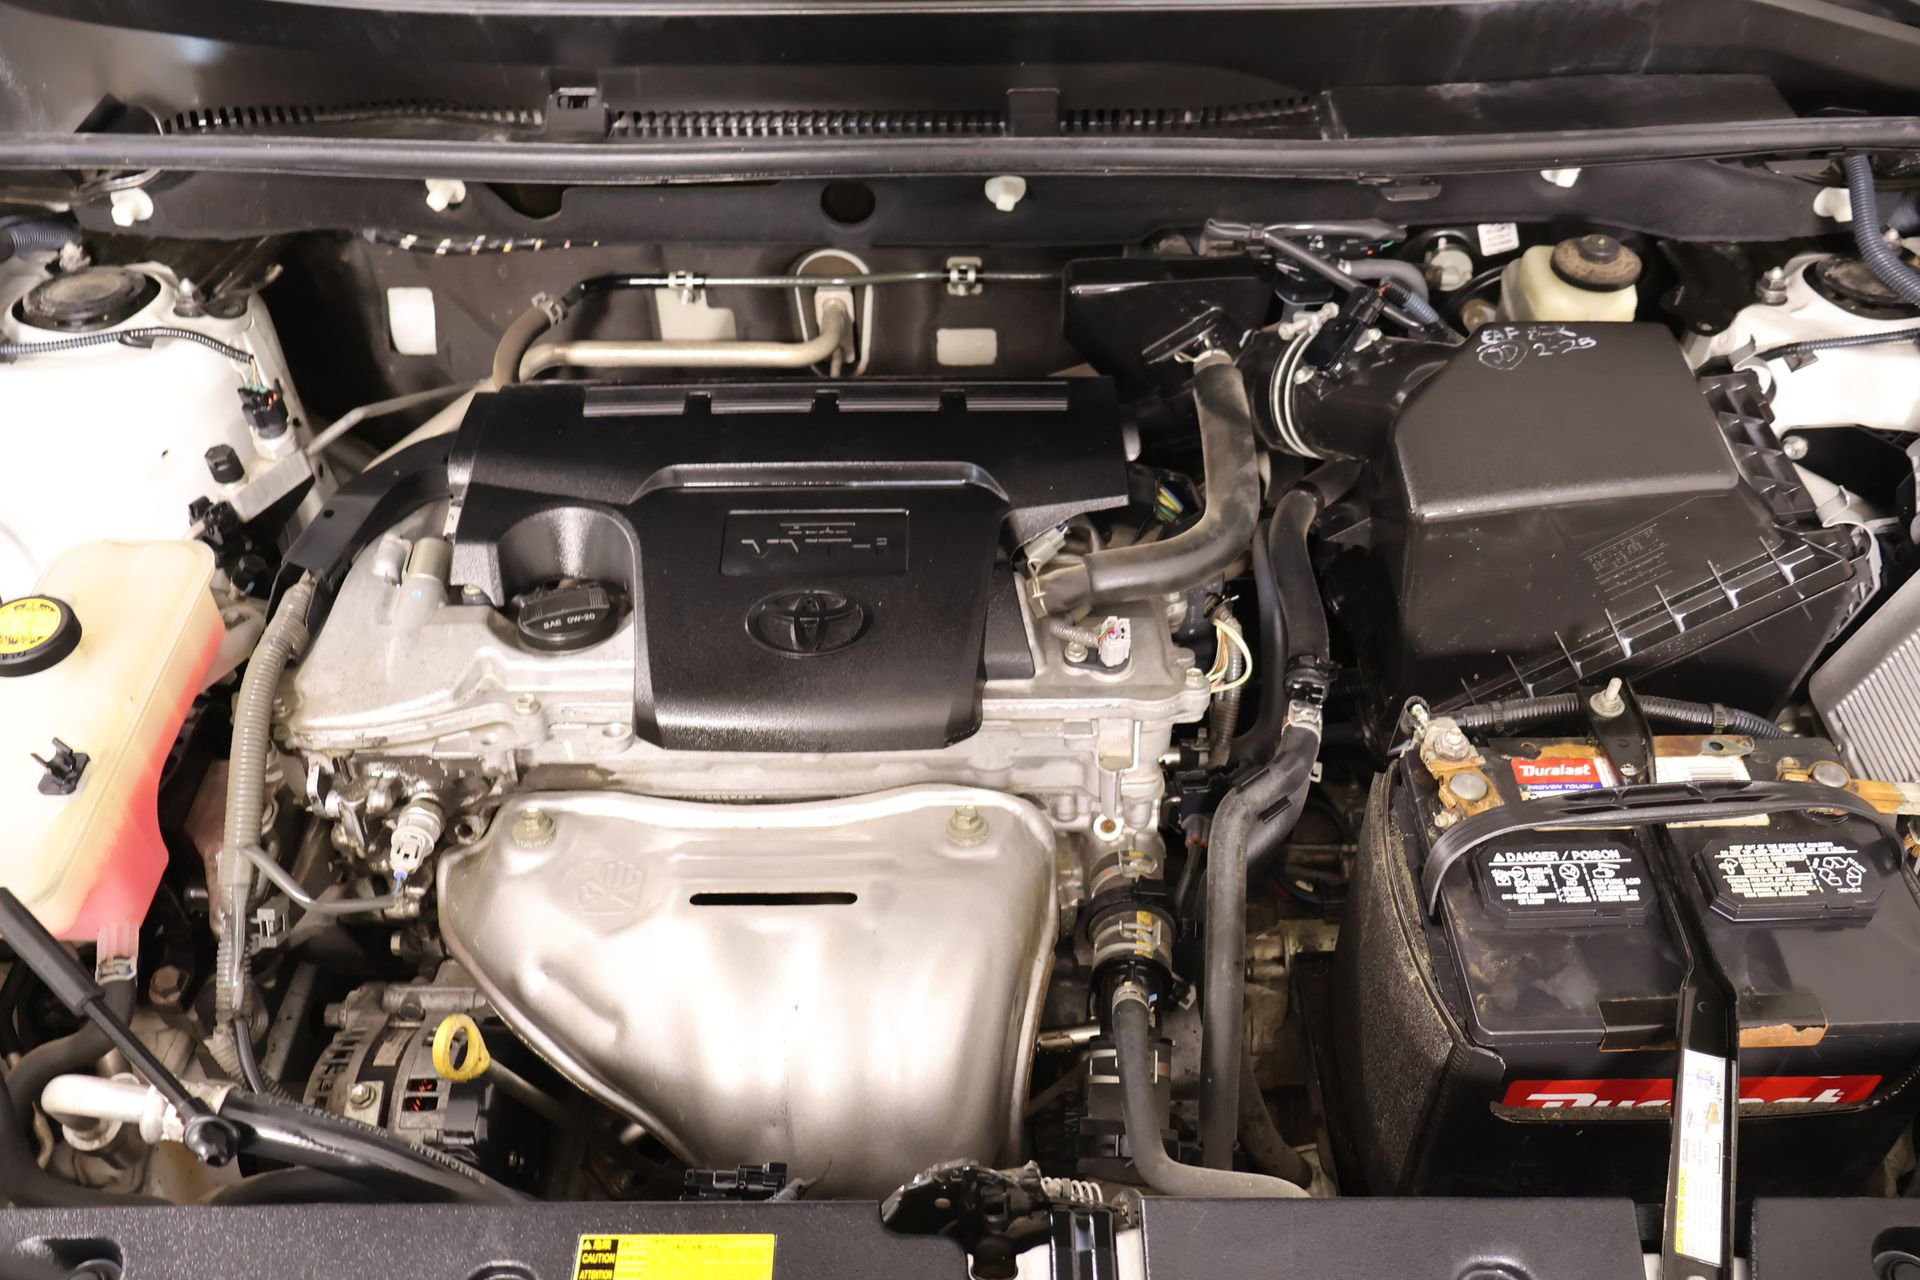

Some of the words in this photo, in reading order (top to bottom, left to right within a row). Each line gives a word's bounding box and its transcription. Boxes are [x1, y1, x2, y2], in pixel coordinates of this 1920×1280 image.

[543, 619, 562, 630] SAE
[566, 612, 596, 625] 0W-20
[1518, 763, 1591, 777] Duralast
[1506, 851, 1559, 862] DANGER
[1571, 849, 1620, 860] POISON
[582, 1252, 616, 1264] CAUTION
[579, 1269, 613, 1280] ATTENTION
